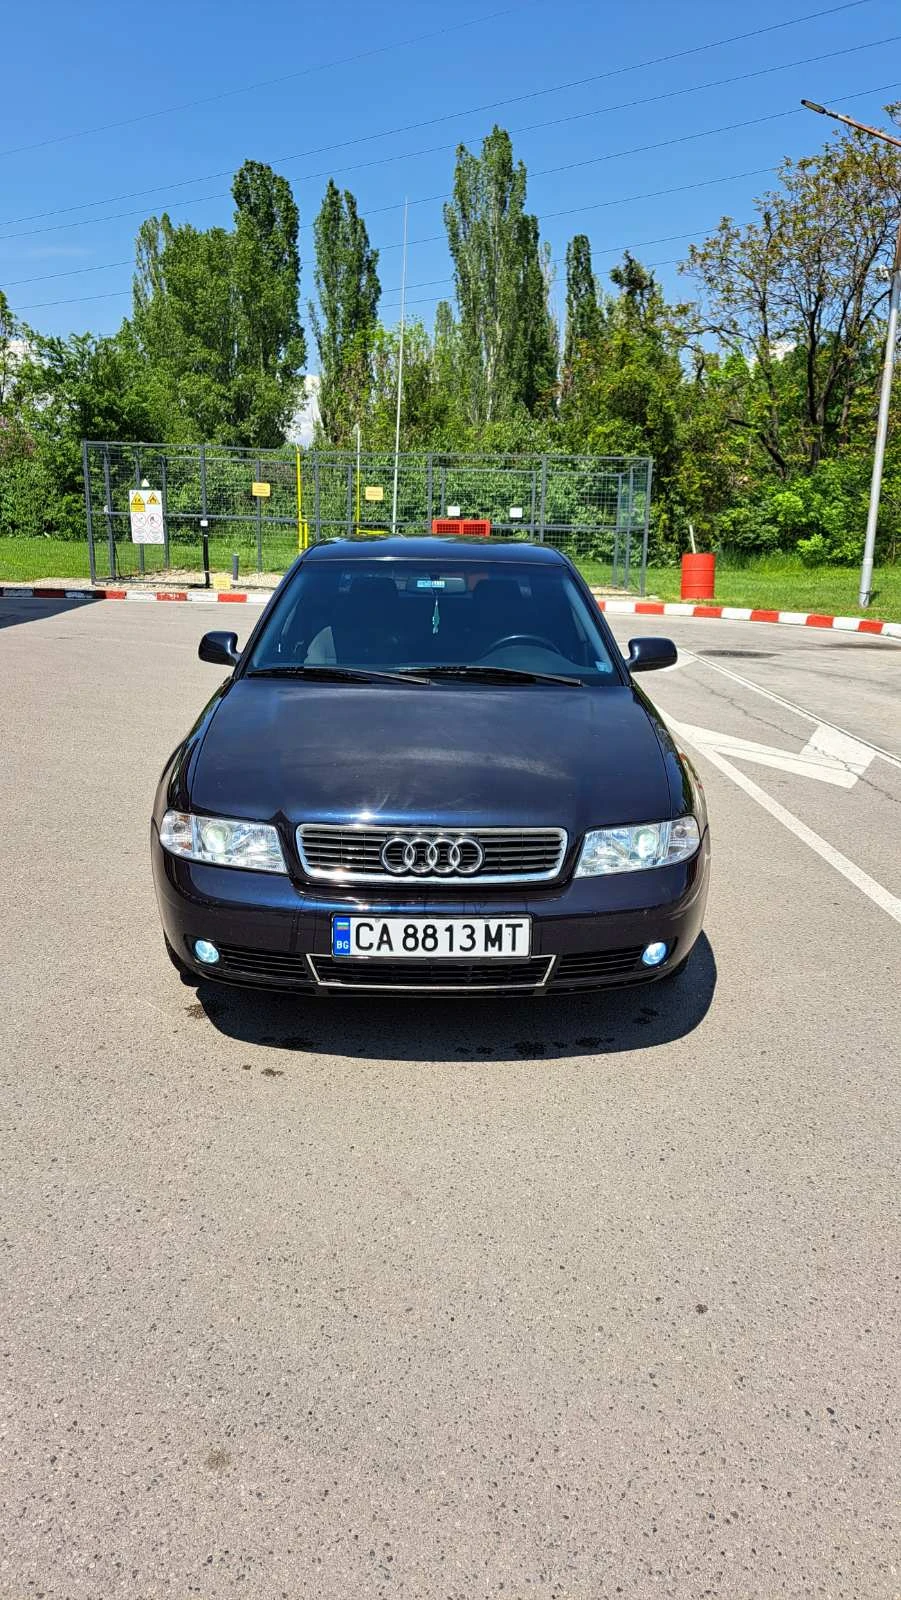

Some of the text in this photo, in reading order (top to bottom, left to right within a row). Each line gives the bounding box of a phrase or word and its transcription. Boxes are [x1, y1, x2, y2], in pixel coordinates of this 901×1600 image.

[336, 940, 349, 949] BG
[355, 922, 523, 952] CA 8813 MT
